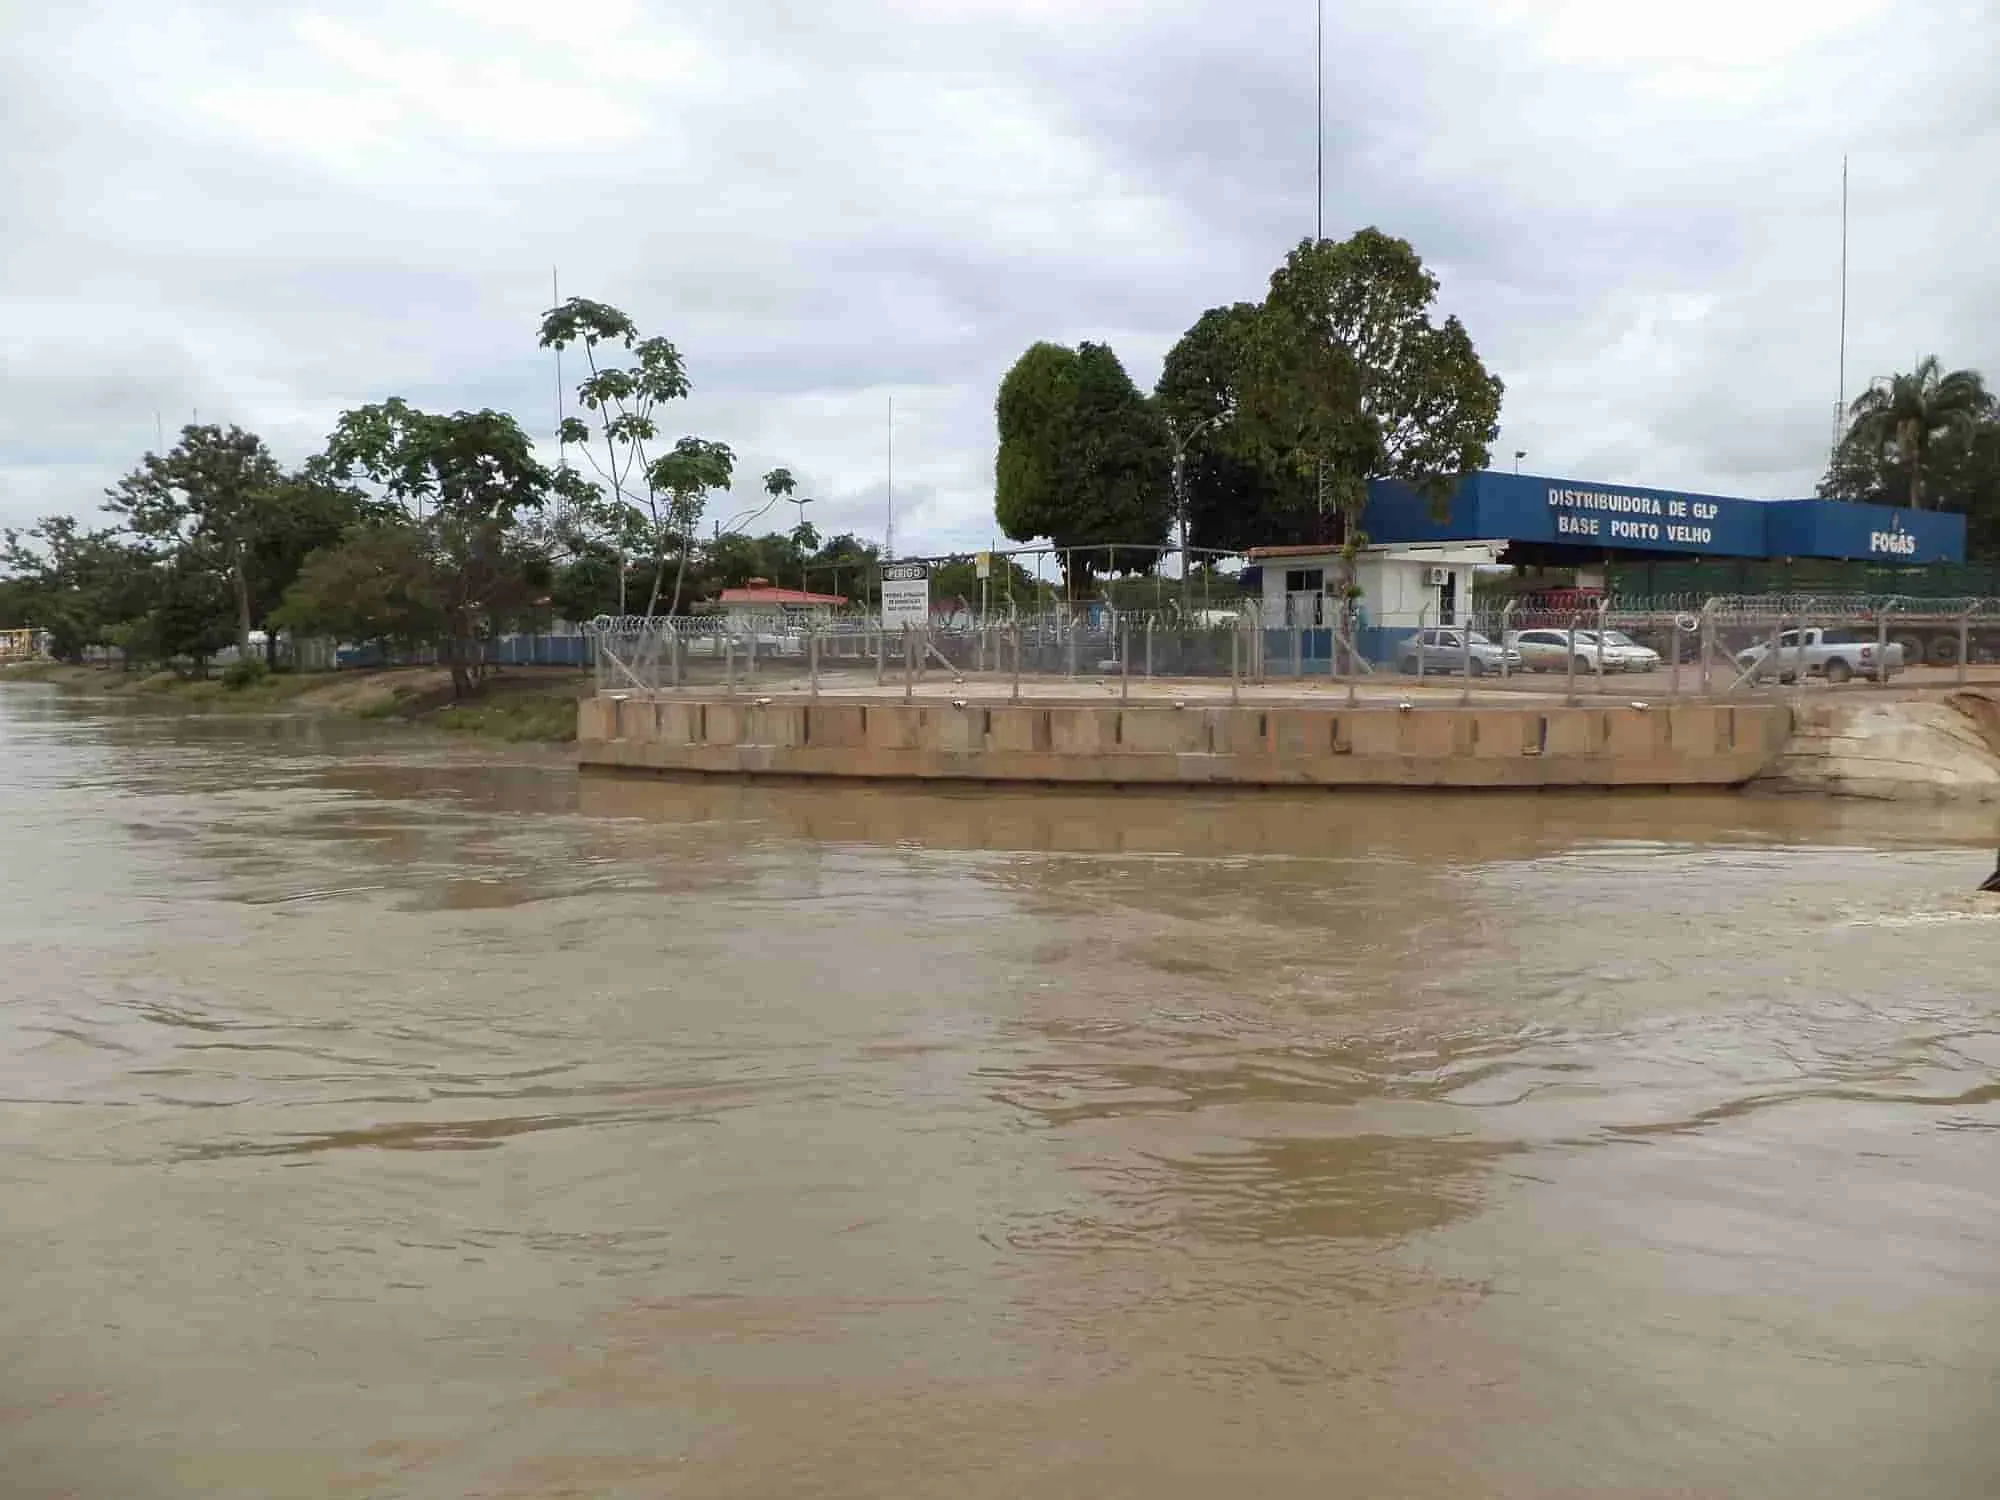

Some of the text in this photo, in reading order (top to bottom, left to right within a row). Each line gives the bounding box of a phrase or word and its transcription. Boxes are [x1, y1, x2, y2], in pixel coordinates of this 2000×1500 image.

[1548, 488, 1718, 519] DISTRIBUIDORA DE GLP
[1558, 516, 1711, 543] BASE PORTO VELHO
[1871, 528, 1915, 554] FOGÁS
